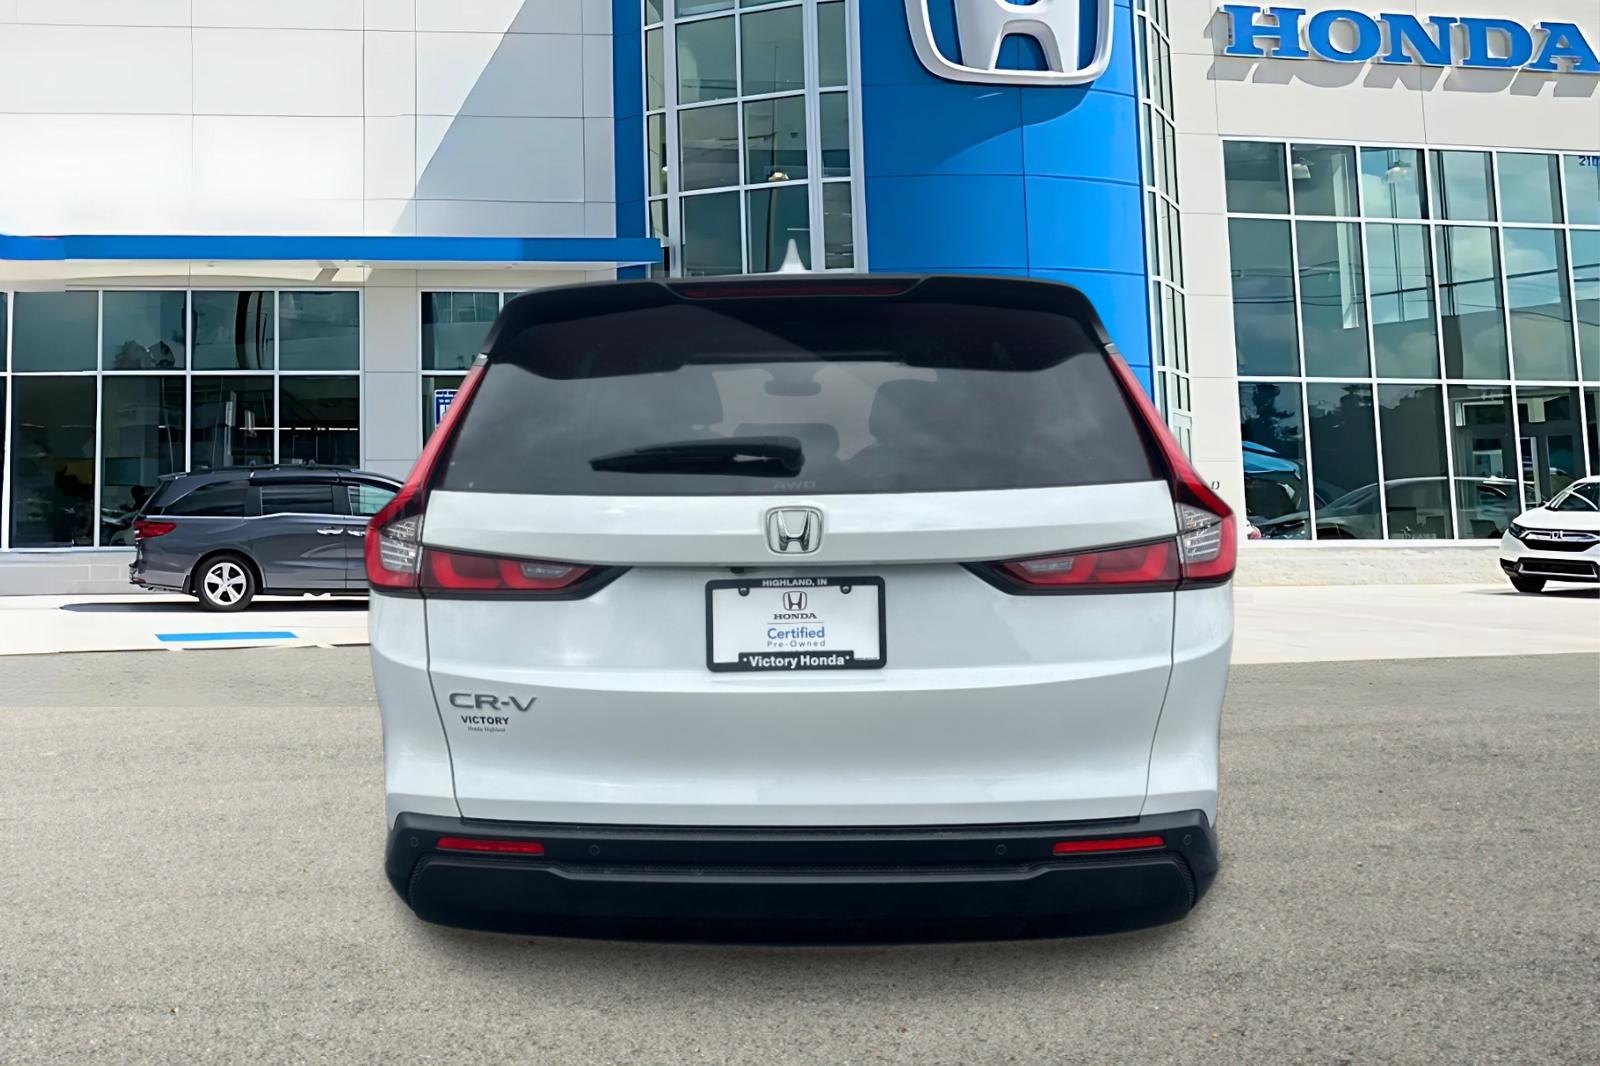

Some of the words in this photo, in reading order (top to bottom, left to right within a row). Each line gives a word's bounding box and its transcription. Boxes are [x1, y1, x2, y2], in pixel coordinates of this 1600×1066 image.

[1218, 4, 1600, 74] HONDA
[773, 479, 817, 489] AWD
[762, 578, 815, 587] HIGHLAND,
[817, 578, 828, 586] IN
[773, 612, 818, 620] HONDA
[767, 626, 825, 640] Certified
[767, 640, 826, 648] Pre-Owned
[749, 656, 798, 669] Victory
[800, 654, 845, 666] Honda
[449, 692, 537, 712] CR-V
[461, 715, 510, 726] VICTORY
